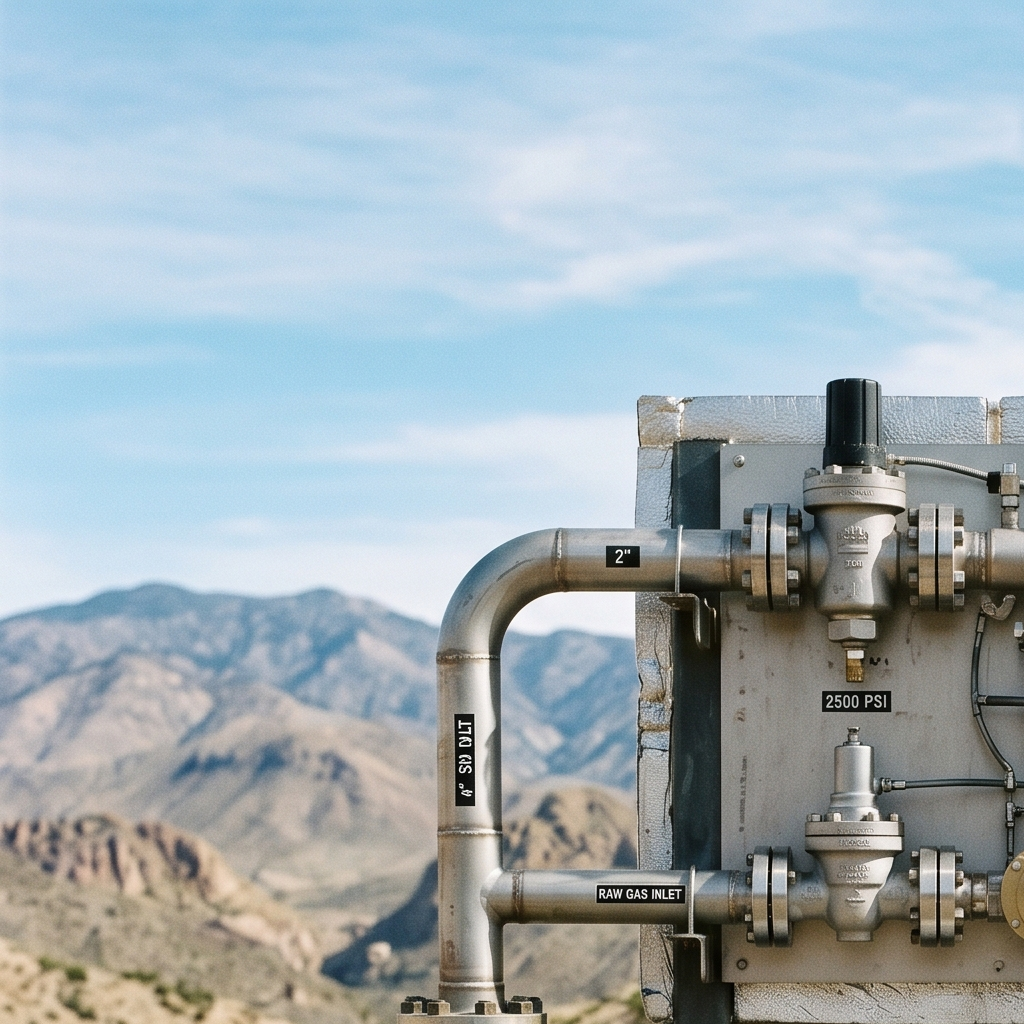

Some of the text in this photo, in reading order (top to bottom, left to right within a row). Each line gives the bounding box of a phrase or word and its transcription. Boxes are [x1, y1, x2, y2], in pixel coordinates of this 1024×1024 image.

[615, 548, 631, 564] 2"
[826, 694, 887, 709] 2500 PSI
[598, 888, 683, 901] RAW GAS INLET
